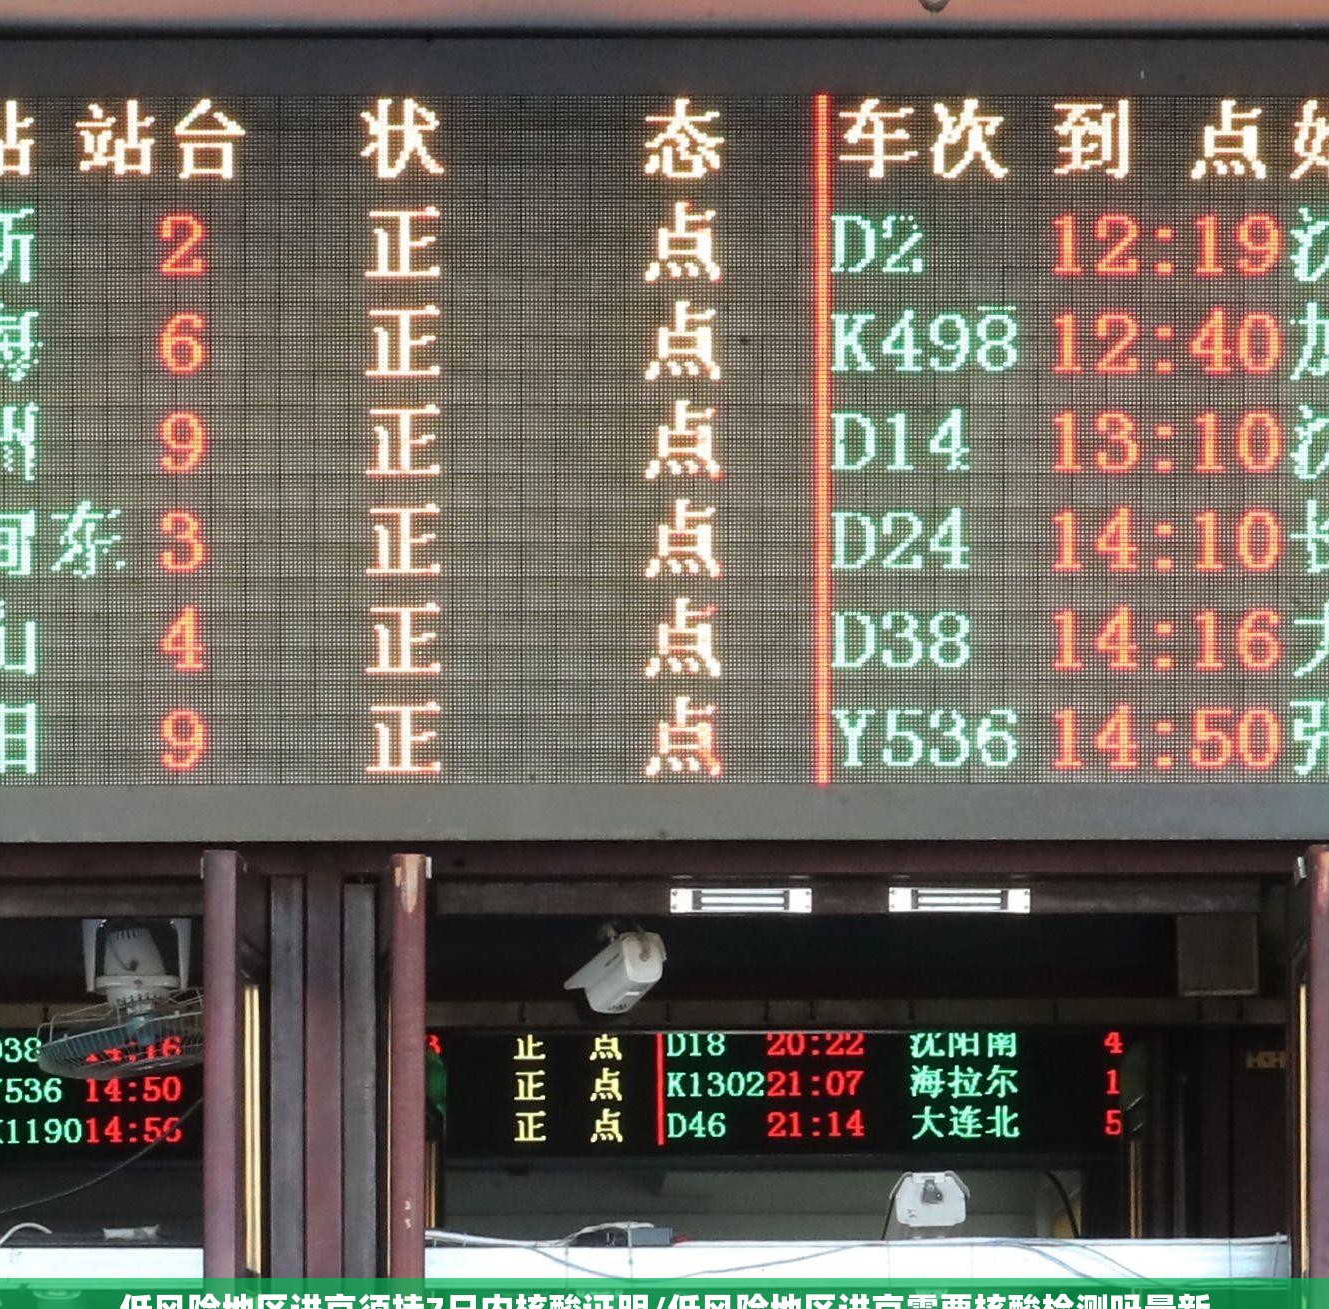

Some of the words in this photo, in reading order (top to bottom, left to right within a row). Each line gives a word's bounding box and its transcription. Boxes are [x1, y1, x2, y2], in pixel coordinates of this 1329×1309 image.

[76, 99, 247, 180] 站台
[838, 99, 1010, 180] 车次
[158, 212, 209, 279] 2
[830, 214, 926, 277] D2
[1052, 213, 1285, 278] 12:19
[158, 311, 209, 378] 6
[830, 309, 1022, 374] K498
[1052, 308, 1285, 377] 12:40
[159, 410, 209, 477] 9
[830, 408, 973, 473] D14
[1052, 410, 1285, 475] 13:10
[159, 509, 209, 576] 3
[831, 507, 972, 572] D24
[1052, 506, 1287, 574] 14:10
[159, 604, 209, 675] 4
[832, 610, 975, 673] D38
[1052, 604, 1285, 673] 14:16
[159, 707, 210, 774] 9
[831, 706, 1022, 771] Y536
[1052, 704, 1285, 773] 14:50
[666, 1032, 726, 1057] D18
[766, 1032, 865, 1057] 20:22
[910, 1032, 1018, 1058] 沈阳南
[1103, 1032, 1124, 1054] 4
[86, 1076, 183, 1103] 14:50
[666, 1071, 765, 1098] K1302
[766, 1070, 865, 1097] 21:07
[910, 1065, 1020, 1099] 海拉尔
[1106, 1069, 1121, 1095] 1
[86, 1116, 183, 1144] 14:56
[667, 1112, 727, 1139] D46
[767, 1109, 865, 1137] 21:14
[912, 1105, 1021, 1140] 大连北
[1104, 1109, 1123, 1137] 5
